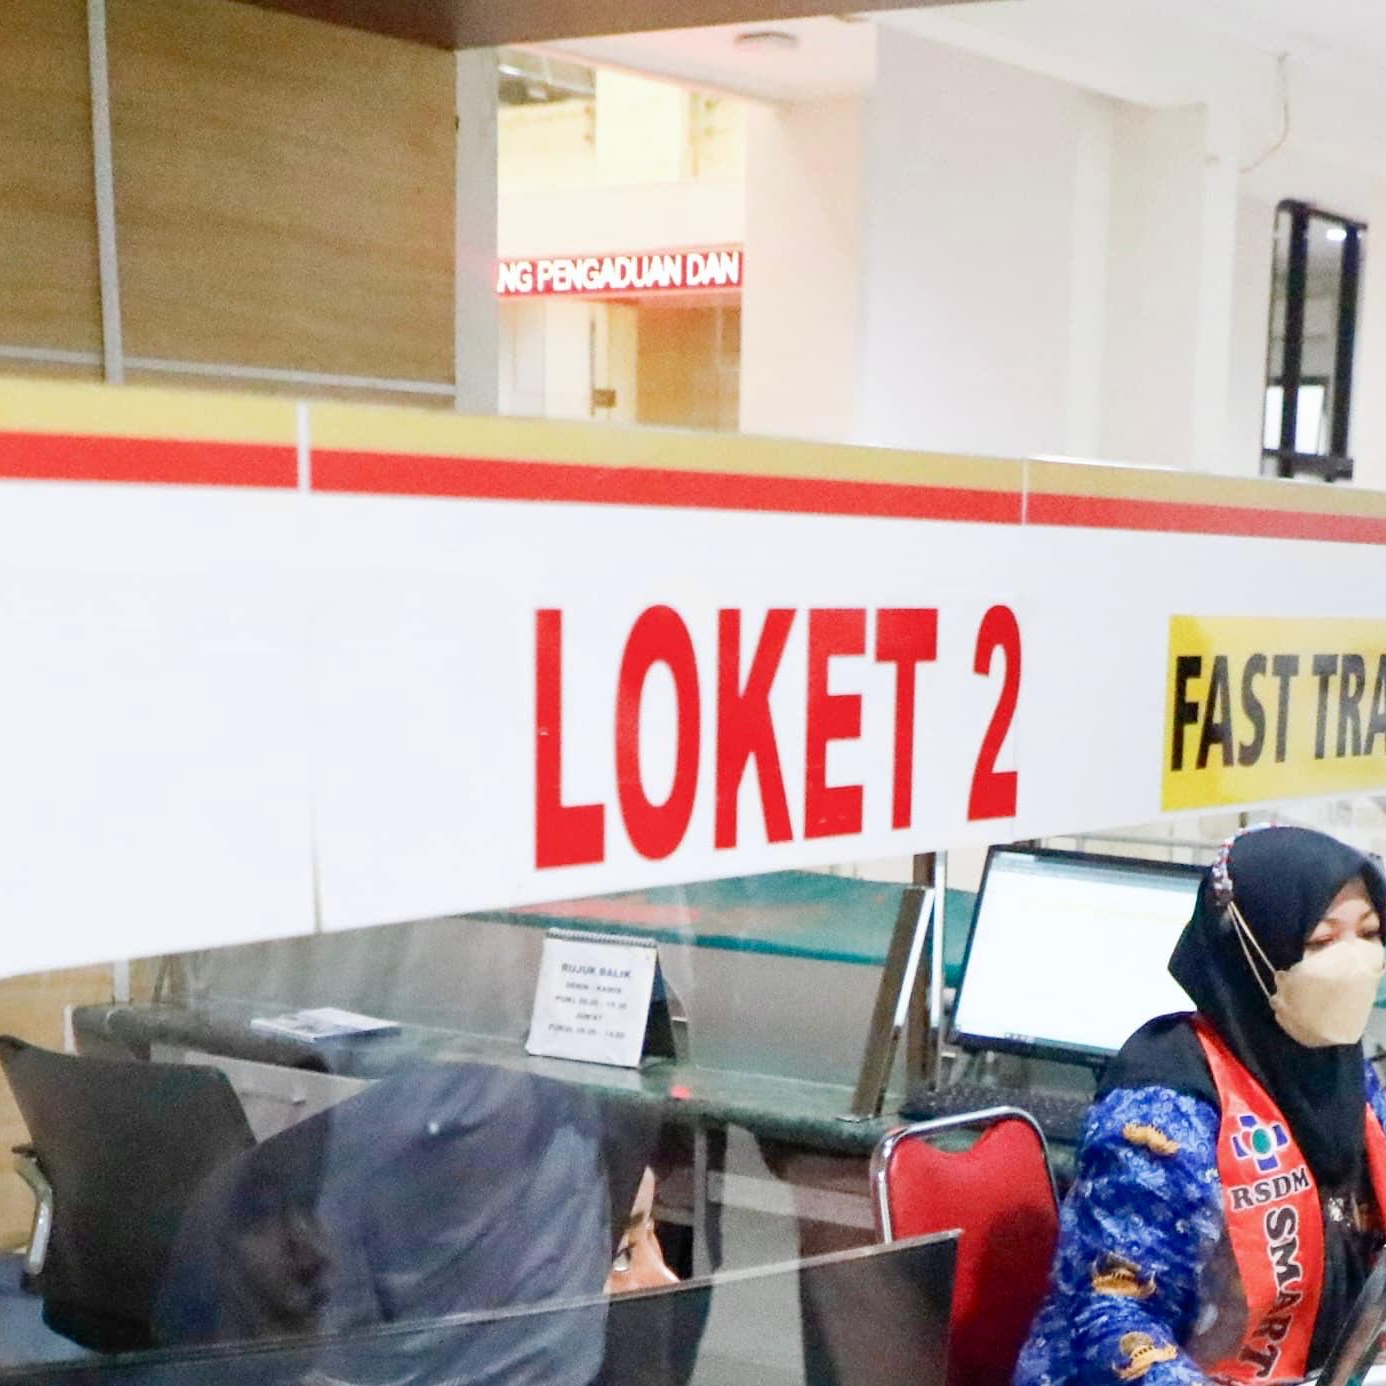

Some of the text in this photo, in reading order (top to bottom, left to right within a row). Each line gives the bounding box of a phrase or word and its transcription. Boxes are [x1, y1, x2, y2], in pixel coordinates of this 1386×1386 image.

[497, 251, 739, 293] NG PENGADUAN DAN
[535, 604, 1022, 870] LOKET 2
[1171, 653, 1300, 772] FAST
[1230, 1166, 1310, 1211] RSDM
[1239, 1205, 1303, 1380] SMART
